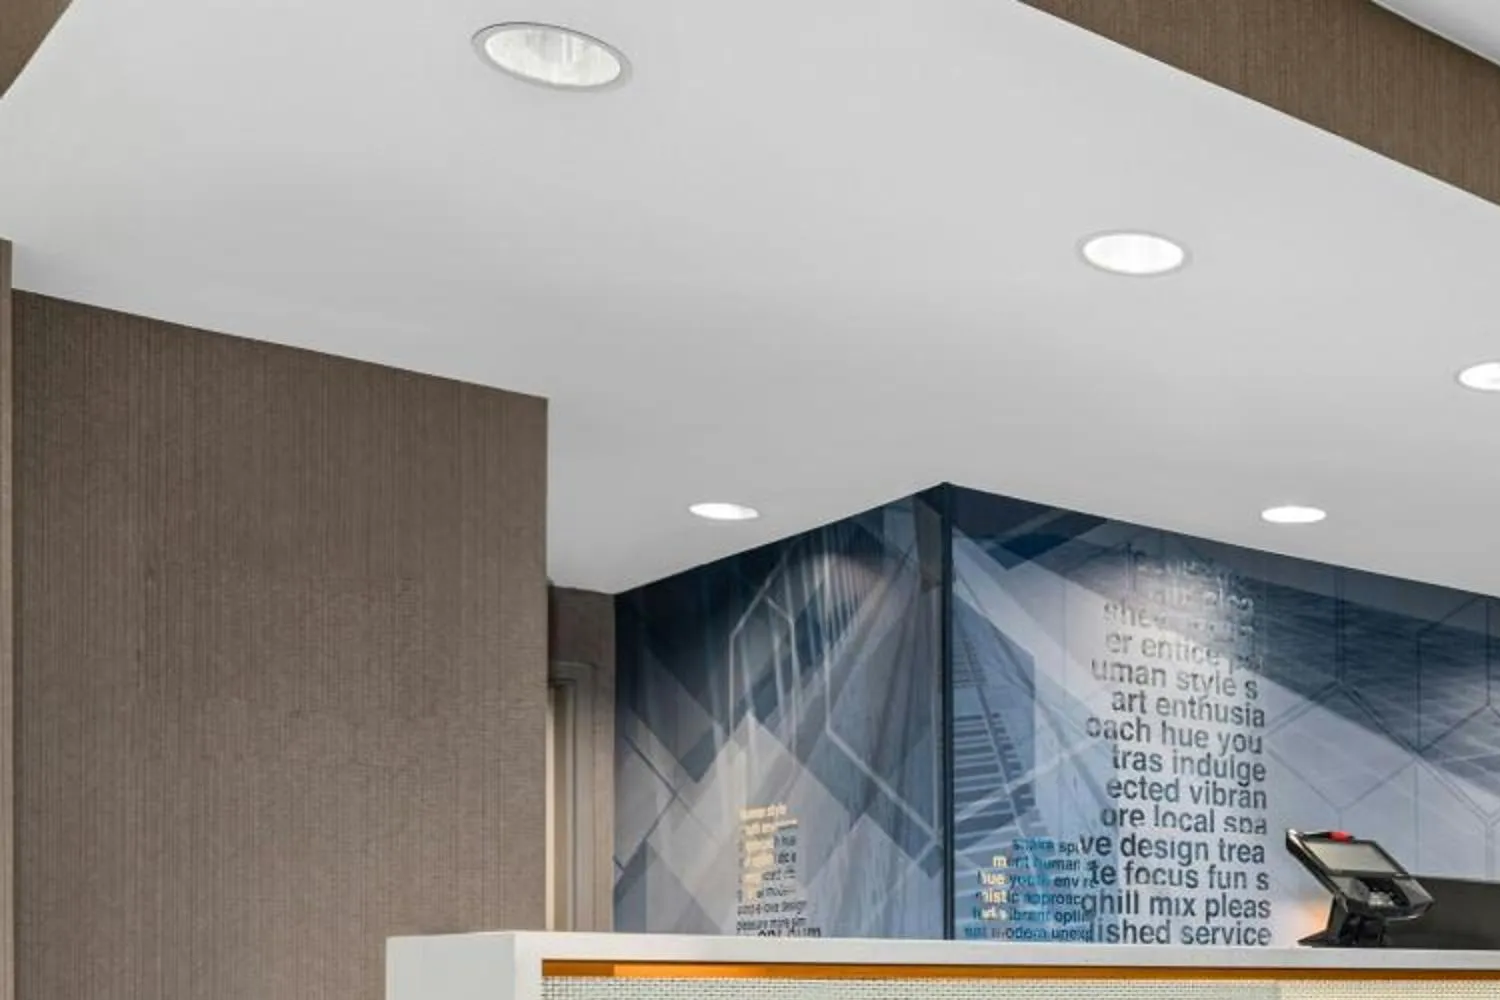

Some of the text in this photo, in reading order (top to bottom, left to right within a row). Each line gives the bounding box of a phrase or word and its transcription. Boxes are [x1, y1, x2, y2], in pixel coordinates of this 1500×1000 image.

[1091, 658, 1259, 701] uman style s
[1112, 689, 1266, 728] art enthusia
[1085, 716, 1263, 758] oach hue you
[1112, 743, 1267, 788] tras indulge
[1105, 775, 1268, 810] ected vibran
[1101, 806, 1146, 828] ore
[1153, 803, 1216, 834] local
[1078, 834, 1113, 857] ve
[1120, 832, 1209, 868] design
[1219, 837, 1266, 864] trea
[1124, 859, 1200, 889] focus
[1208, 863, 1248, 890] fun
[1255, 871, 1270, 892] s
[1149, 896, 1197, 918] mix
[1205, 892, 1272, 925] pleas
[1180, 921, 1273, 946] service
